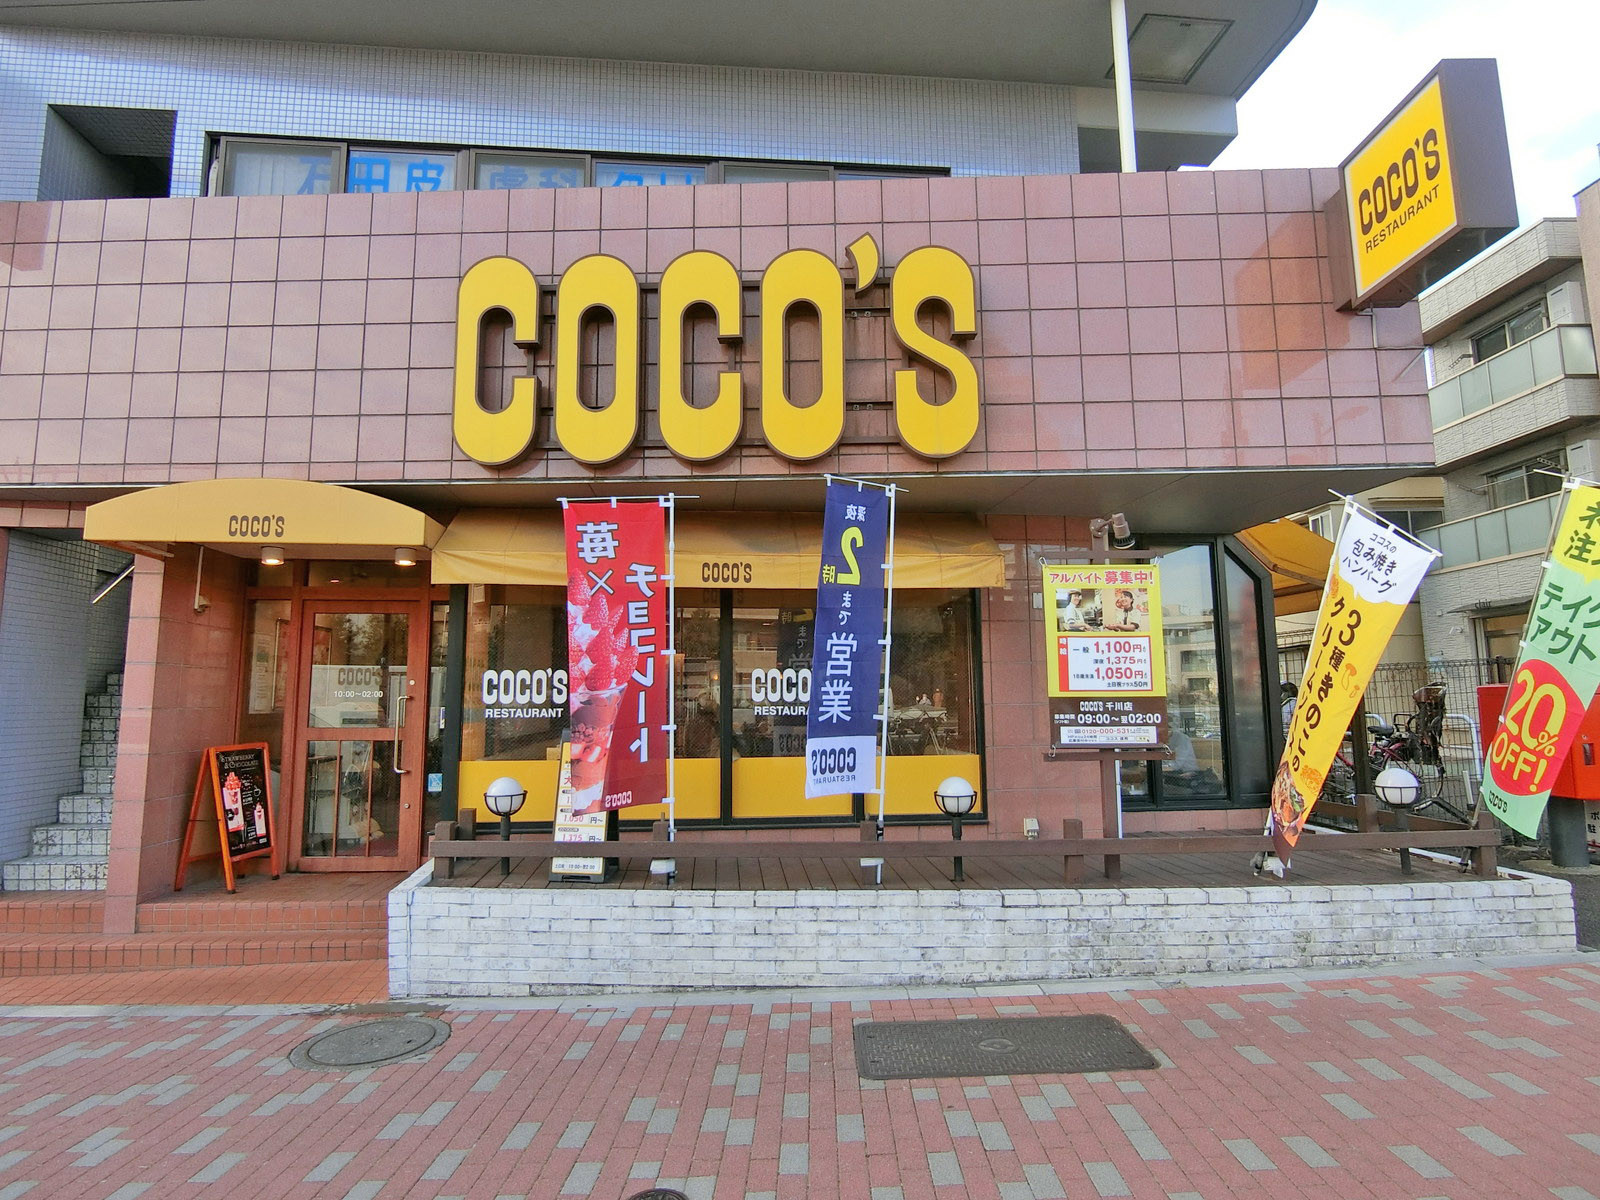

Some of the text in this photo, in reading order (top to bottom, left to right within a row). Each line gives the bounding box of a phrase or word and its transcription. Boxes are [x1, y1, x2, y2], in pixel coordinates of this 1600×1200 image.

[1358, 128, 1441, 236] COCO'S
[1365, 184, 1440, 254] RESTAURANT
[452, 232, 980, 467] COCO'S
[228, 514, 285, 538] COCO'S
[1369, 532, 1398, 555] ココスの
[701, 562, 753, 584] COCO'S
[1342, 555, 1398, 595] ハンバーグ
[1352, 538, 1398, 577] 包み焼き
[1530, 615, 1597, 665] アウト
[338, 666, 383, 686] COCO'S
[482, 667, 568, 705] COCO'S
[751, 667, 813, 703] COCO
[485, 708, 564, 718] RESTAURANT
[1079, 700, 1133, 711] COCO'S 千川店
[1491, 732, 1548, 793] OFF!
